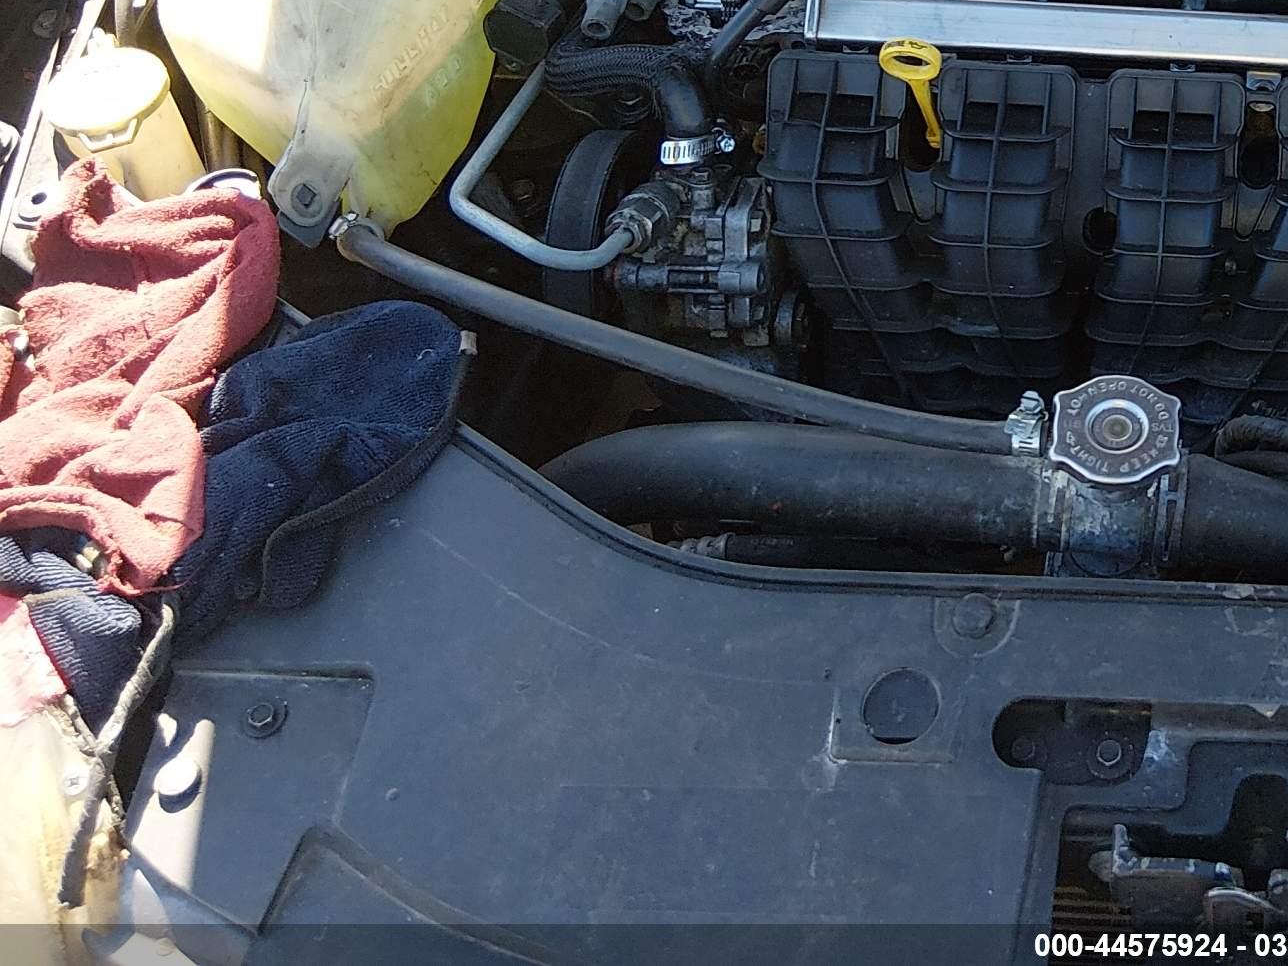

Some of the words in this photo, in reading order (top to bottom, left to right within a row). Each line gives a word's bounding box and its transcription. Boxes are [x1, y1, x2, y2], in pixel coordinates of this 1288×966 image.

[1087, 380, 1129, 397] OPEN
[1130, 387, 1159, 404] NOT
[1066, 392, 1089, 417] HOT
[1154, 402, 1170, 421] DO
[1069, 444, 1111, 474] TIGHT
[1119, 448, 1161, 474] KEEP
